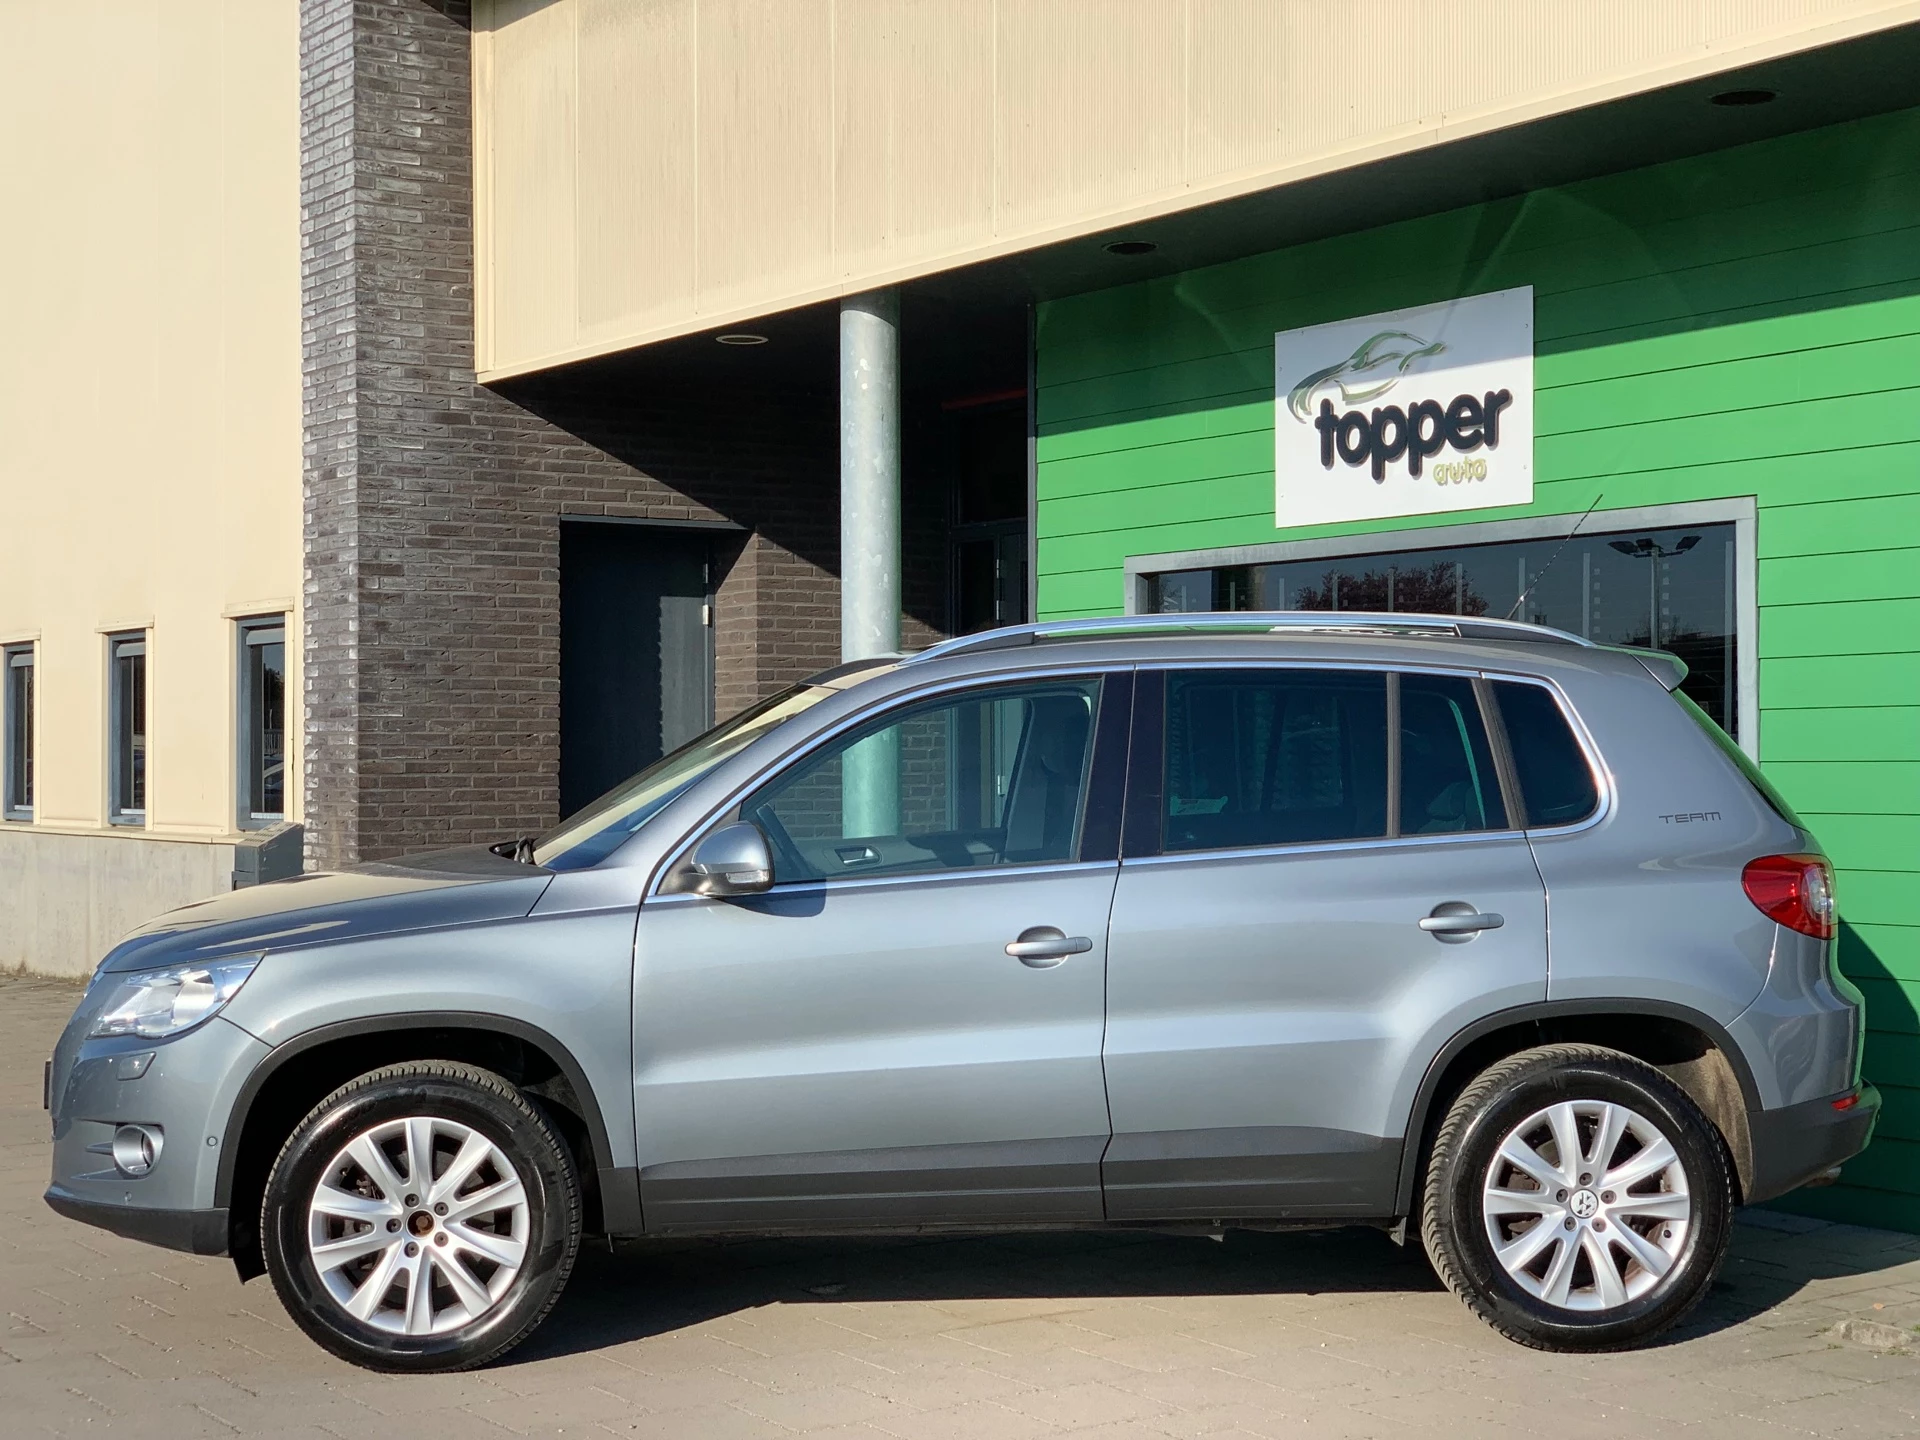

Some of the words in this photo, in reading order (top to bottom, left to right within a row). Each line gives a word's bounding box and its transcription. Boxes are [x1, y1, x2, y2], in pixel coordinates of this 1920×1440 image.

[1314, 388, 1512, 483] topper
[1433, 456, 1487, 485] auto
[1658, 811, 1722, 824] TEAM
